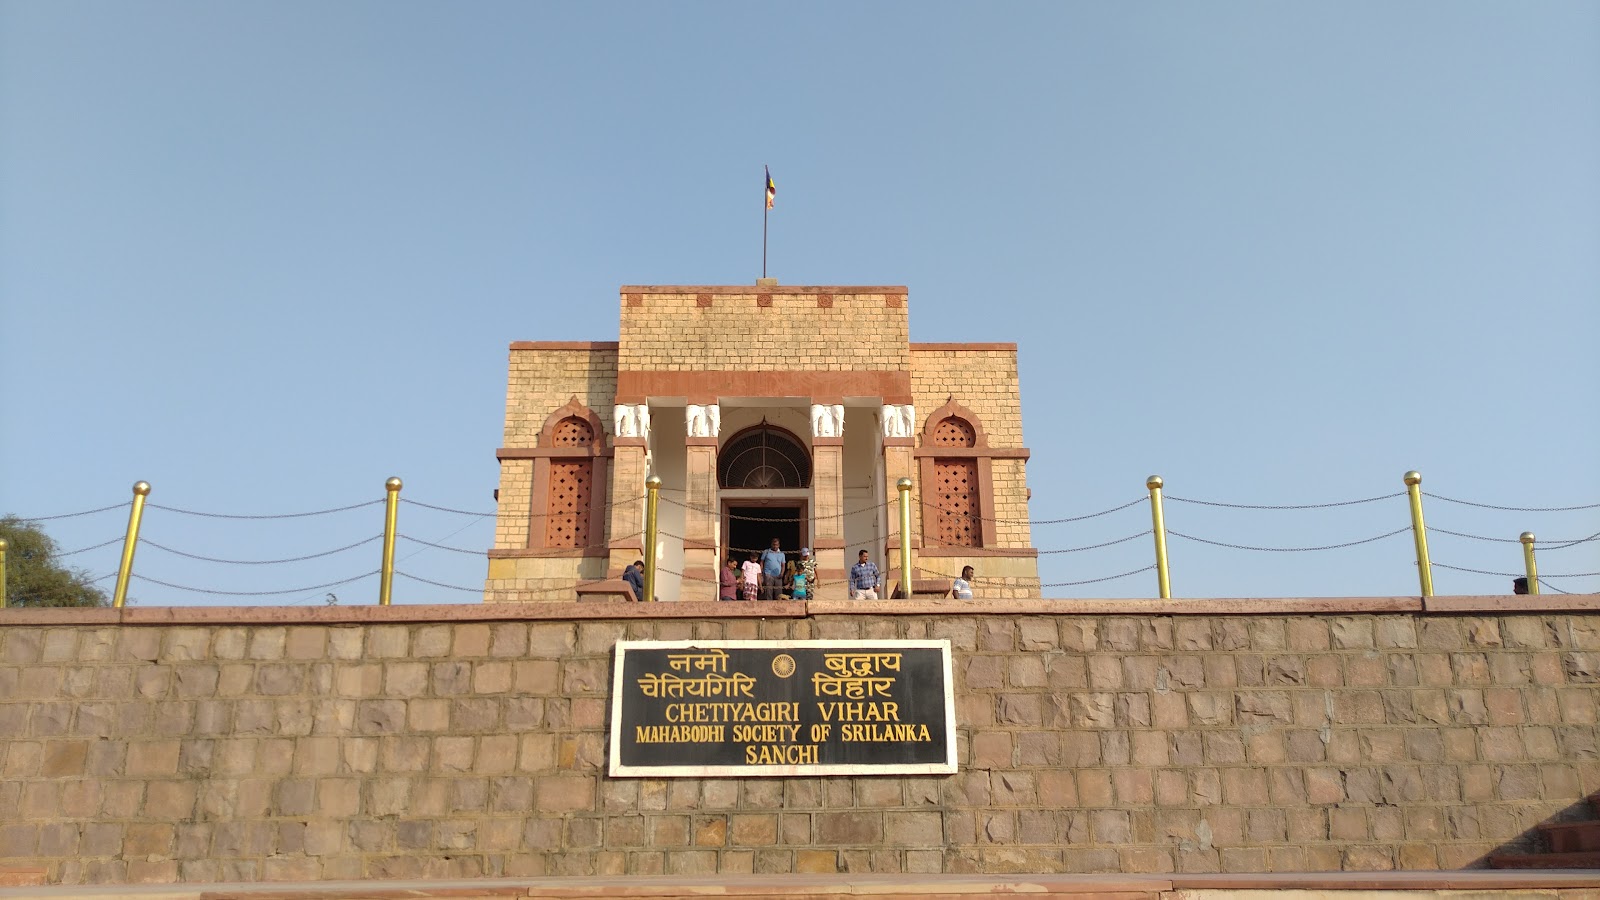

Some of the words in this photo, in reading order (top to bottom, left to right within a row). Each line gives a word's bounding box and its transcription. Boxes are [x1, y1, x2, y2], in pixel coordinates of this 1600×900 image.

[667, 649, 729, 673] नमो
[637, 672, 757, 698] चेतियगिरि
[811, 672, 896, 699] विहार
[666, 702, 799, 723] CHETIYAGIRI
[817, 702, 899, 722] VIHAR
[635, 725, 725, 743] MAHABODHI
[733, 724, 801, 742] SOCIETY
[811, 724, 831, 742] OF
[842, 724, 931, 742] SRILANKA
[746, 745, 819, 764] SANCHI
